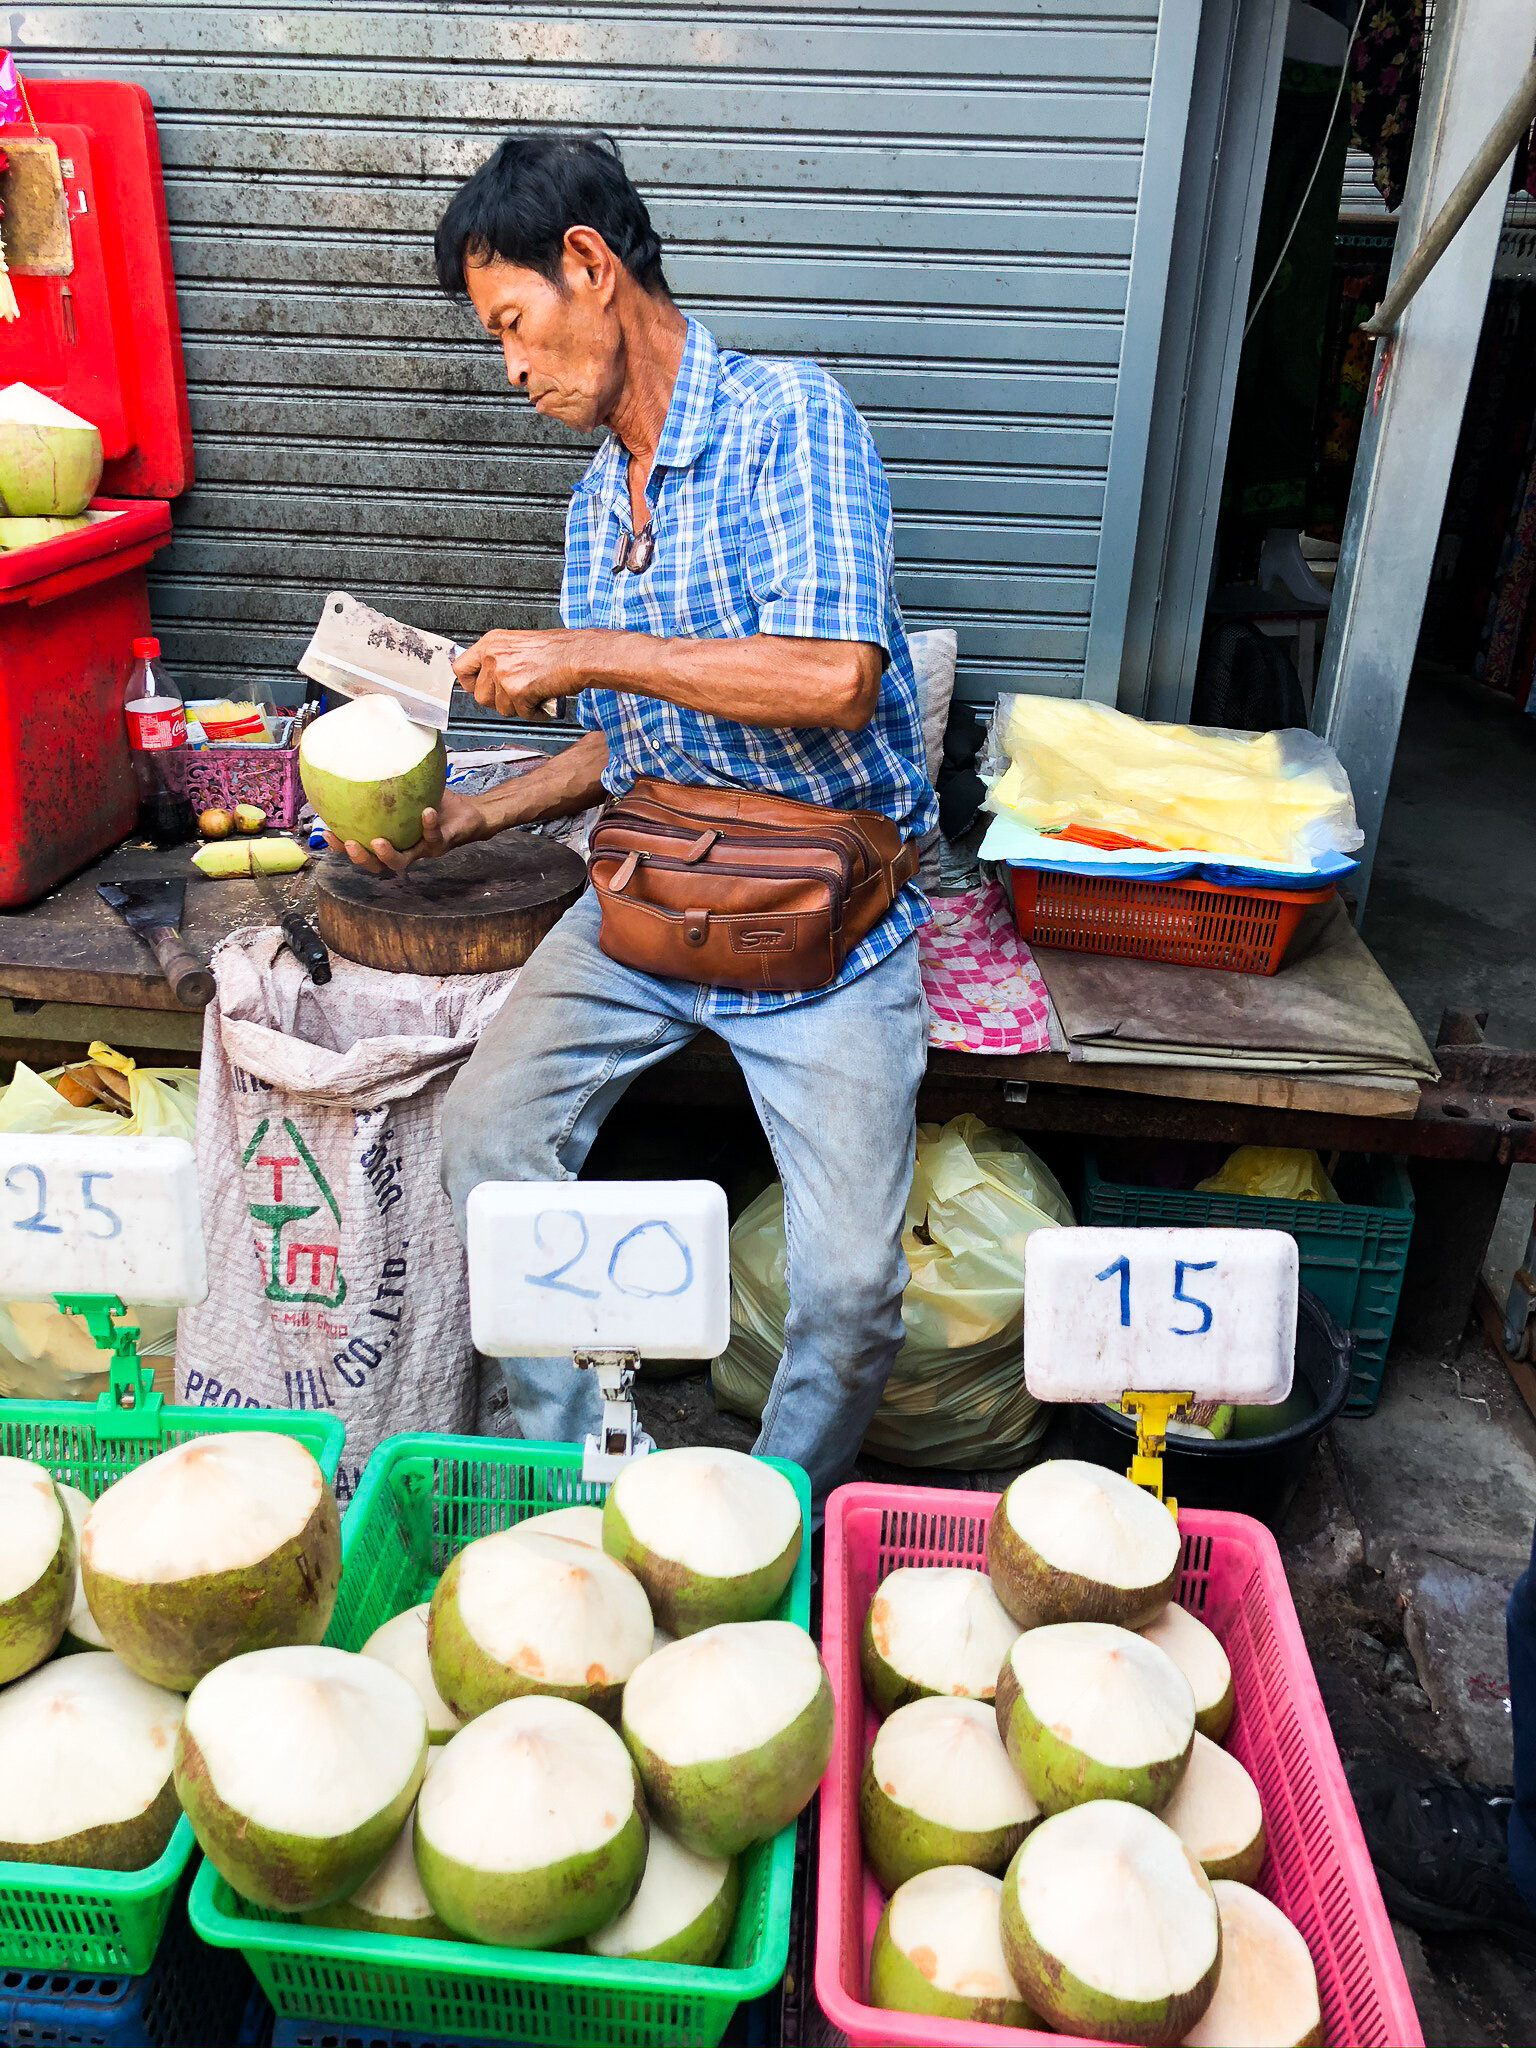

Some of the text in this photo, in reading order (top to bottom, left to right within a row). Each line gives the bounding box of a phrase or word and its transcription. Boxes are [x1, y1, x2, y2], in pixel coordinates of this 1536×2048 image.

[5, 1163, 122, 1239] 25
[524, 1209, 694, 1298] 20
[1095, 1255, 1218, 1335] 15
[184, 1368, 272, 1409] PRO
